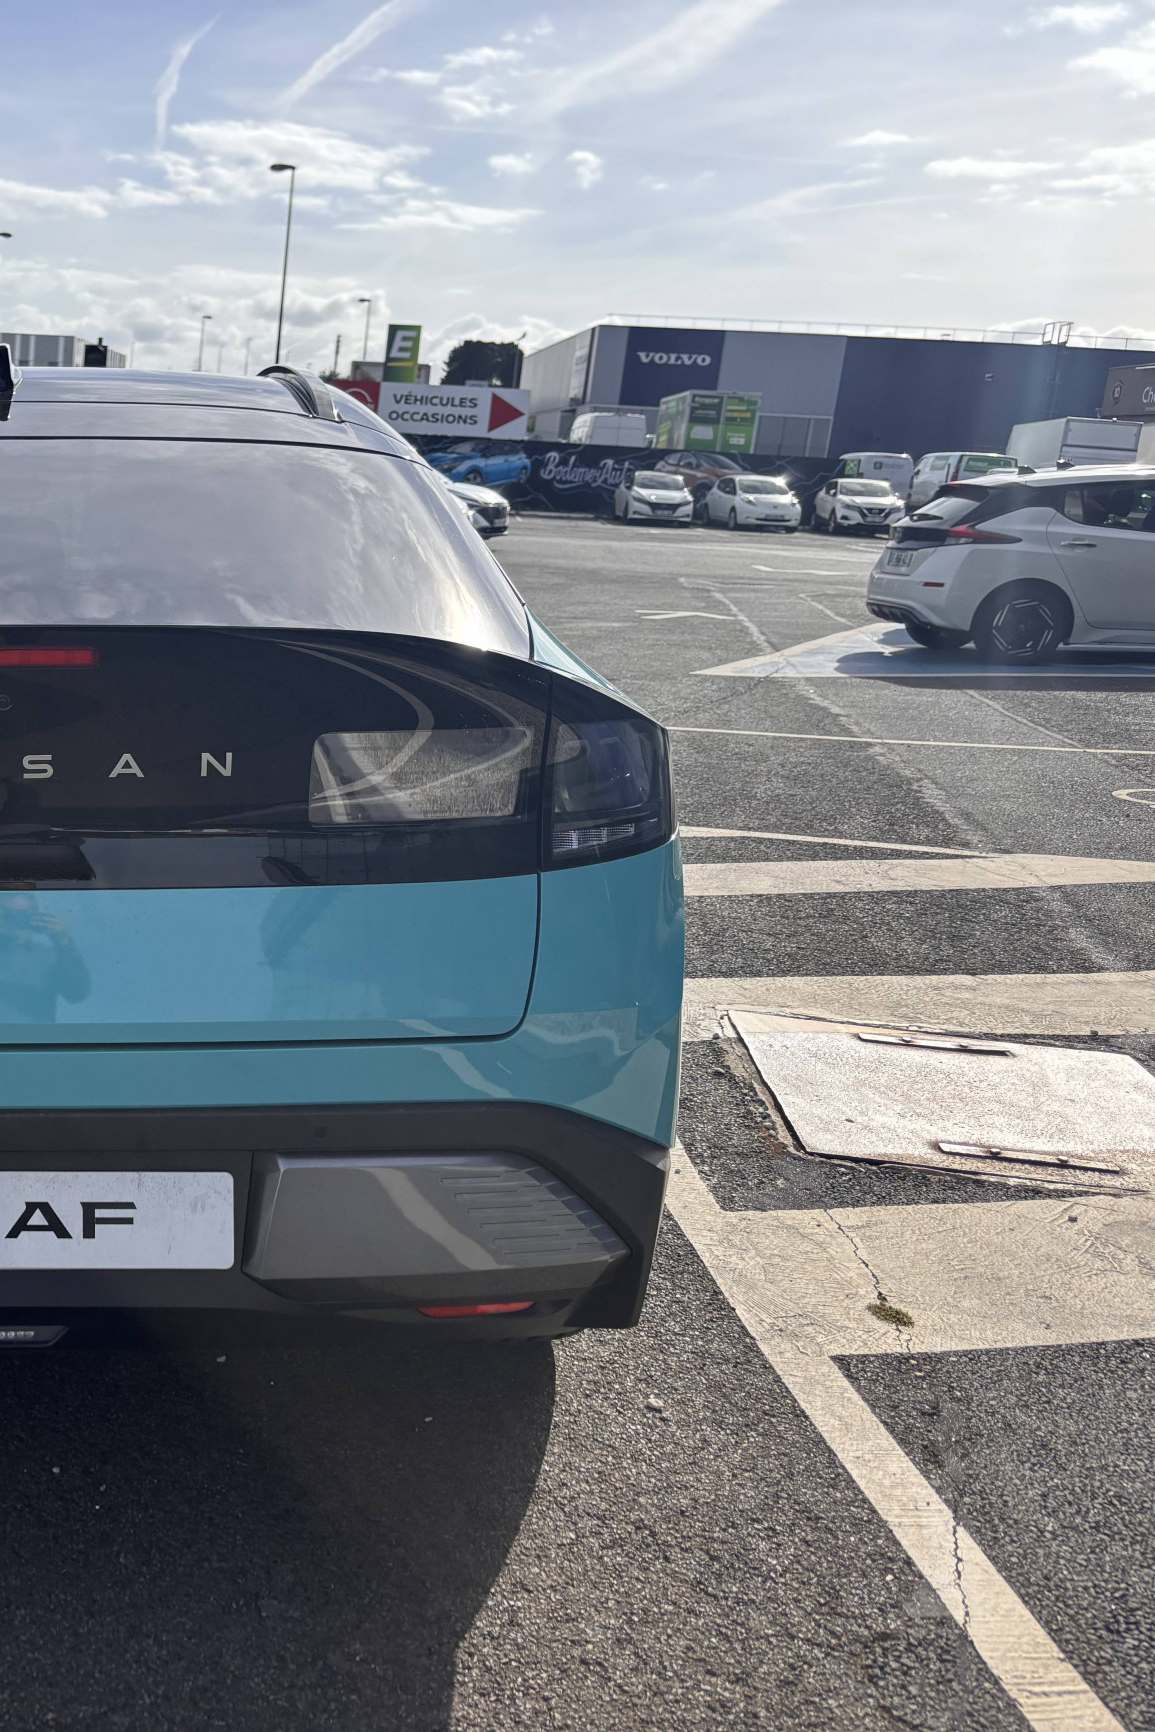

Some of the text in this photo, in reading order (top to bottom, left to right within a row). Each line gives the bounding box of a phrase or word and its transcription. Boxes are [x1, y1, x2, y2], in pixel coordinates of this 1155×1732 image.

[389, 330, 417, 358] E
[636, 351, 712, 366] VOLVO
[393, 391, 478, 409] VÉHICULES
[388, 409, 478, 425] OCCASIONS
